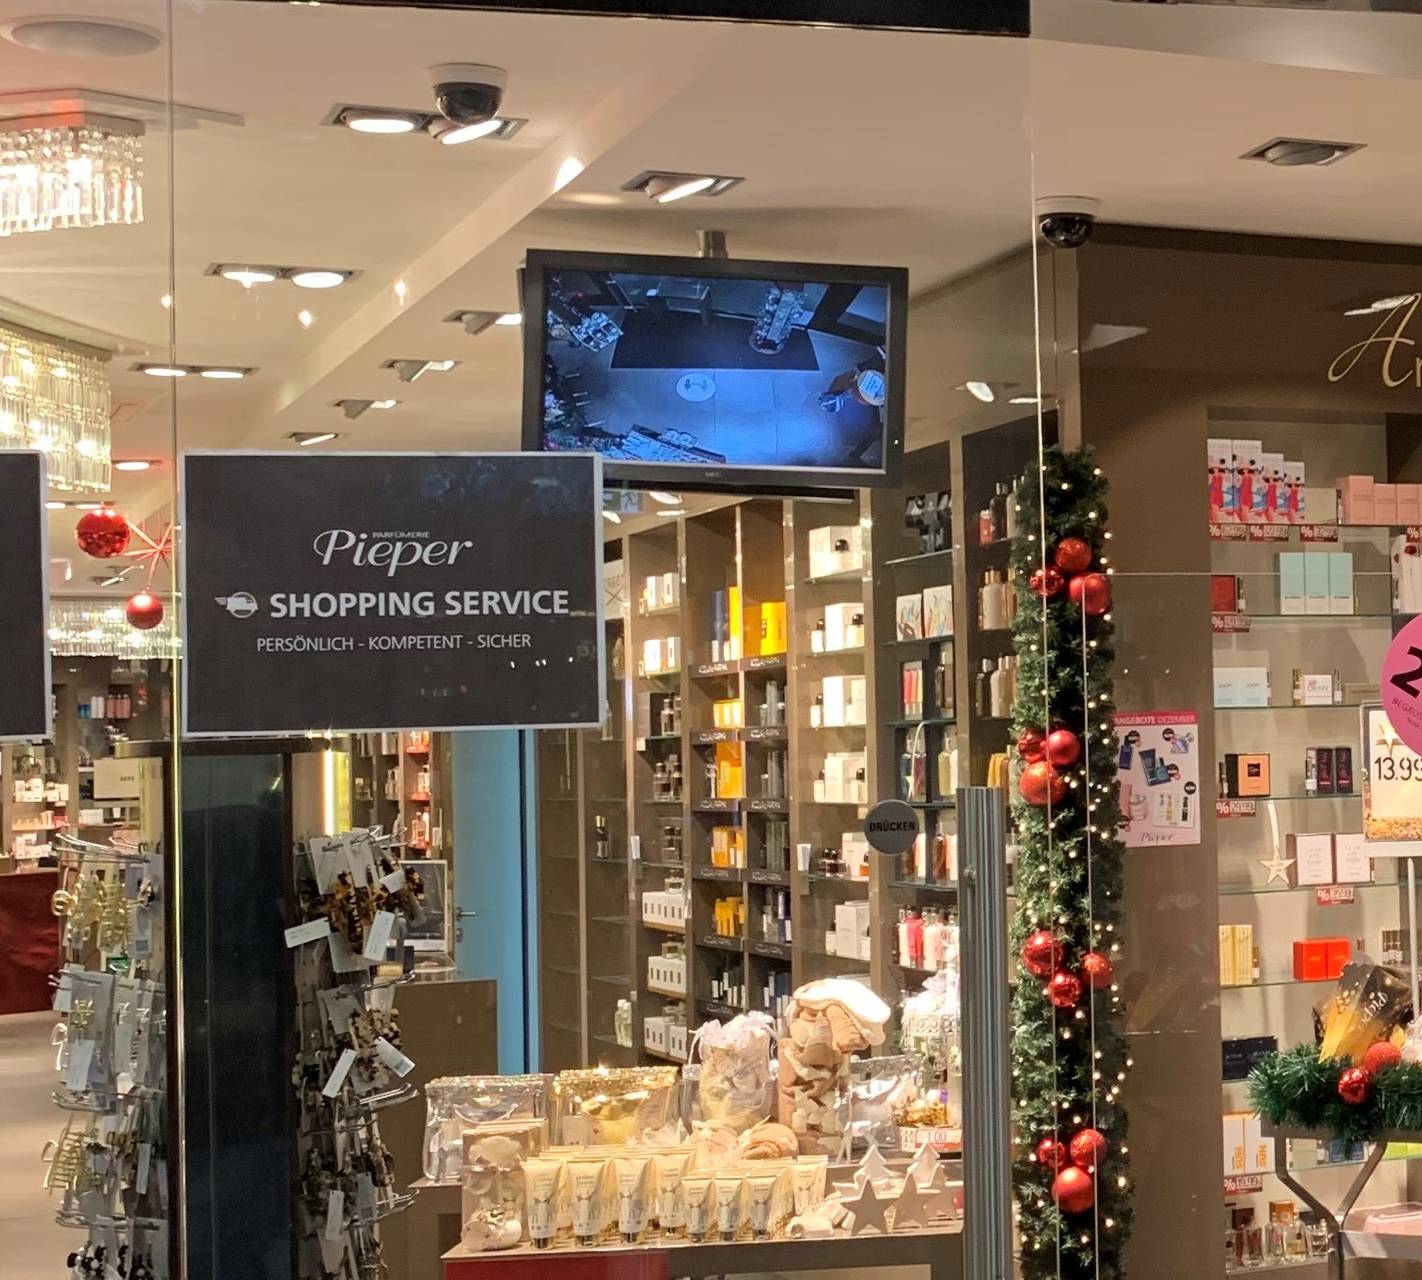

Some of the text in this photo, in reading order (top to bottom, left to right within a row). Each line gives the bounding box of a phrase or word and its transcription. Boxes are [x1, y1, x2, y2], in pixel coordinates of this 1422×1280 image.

[313, 529, 473, 577] Pieper
[270, 590, 569, 618] SHOPPING SERVICE
[257, 635, 353, 652] PERSÖNLICH
[369, 635, 462, 650] KOMPETENT
[478, 634, 532, 648] SICHER
[869, 820, 915, 832] DRÜCKEN
